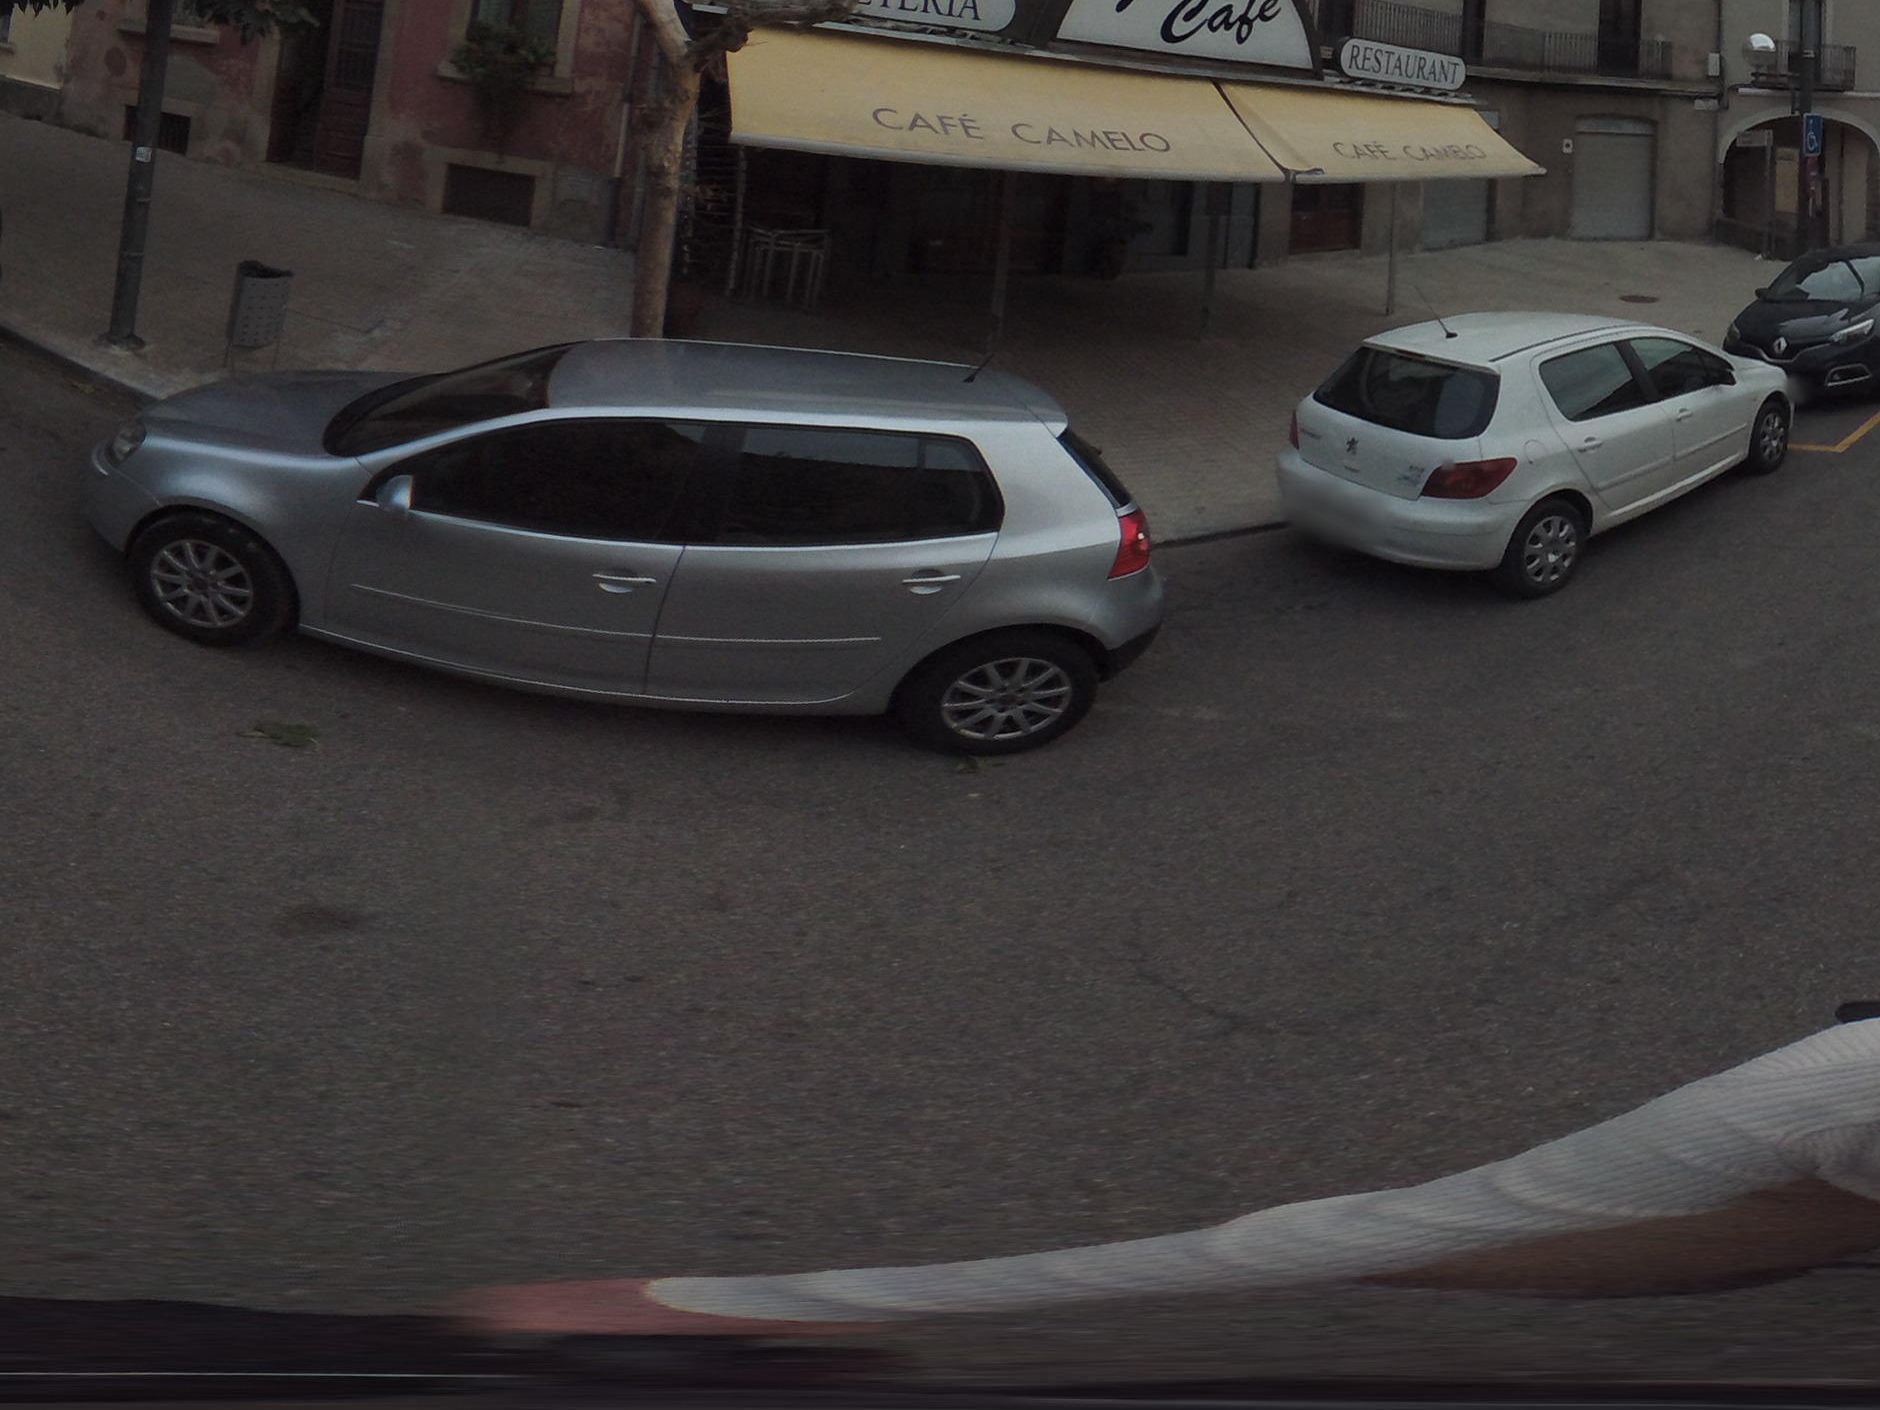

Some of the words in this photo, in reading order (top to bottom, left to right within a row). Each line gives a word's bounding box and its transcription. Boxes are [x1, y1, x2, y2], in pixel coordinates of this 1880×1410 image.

[1348, 44, 1461, 85] RESTAURANT
[871, 107, 984, 140] CAFÉ
[1010, 122, 1171, 153] CAMELO
[1332, 140, 1397, 161] CAFÉ
[1402, 144, 1487, 161] CAMELO
